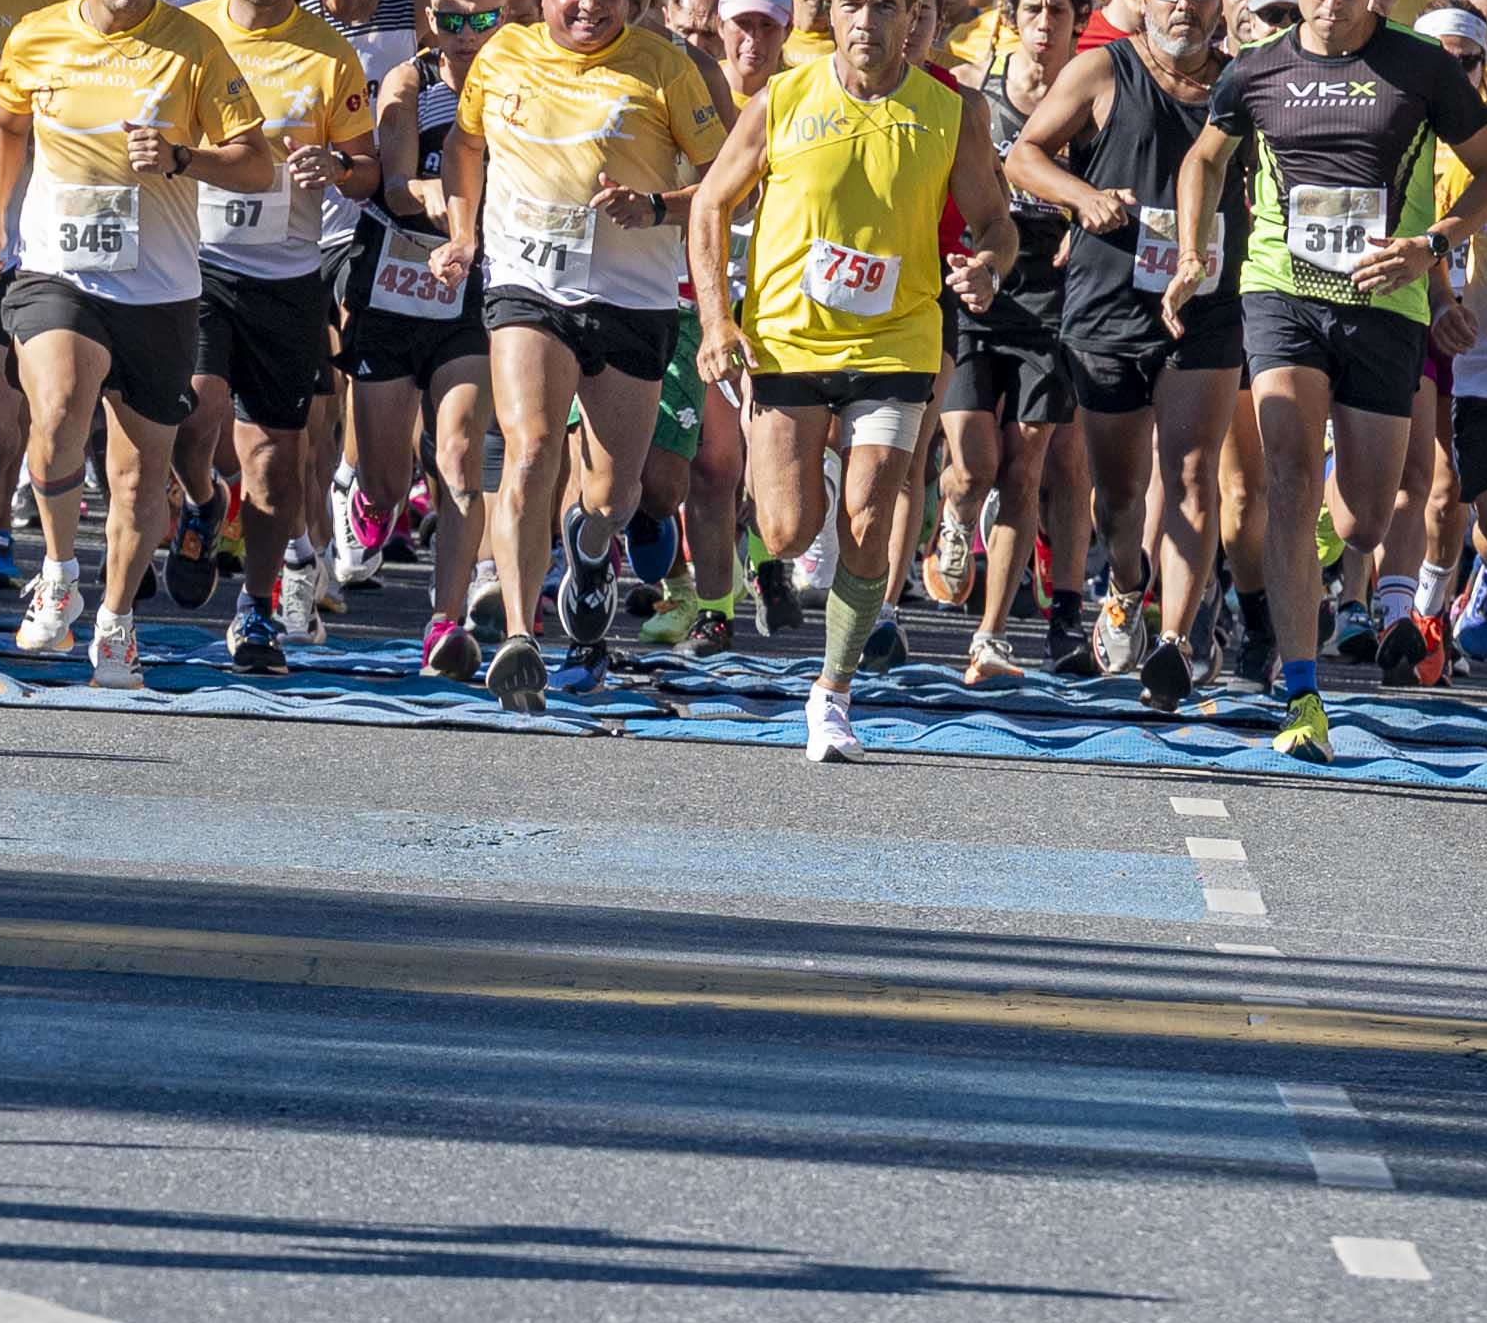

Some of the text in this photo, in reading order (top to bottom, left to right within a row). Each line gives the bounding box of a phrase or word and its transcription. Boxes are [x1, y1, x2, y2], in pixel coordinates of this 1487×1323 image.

[1286, 81, 1376, 97] VKX
[225, 199, 263, 228] 67
[60, 223, 123, 253] 345
[1306, 222, 1367, 254] 318
[520, 237, 567, 271] 271
[824, 248, 886, 292] 759
